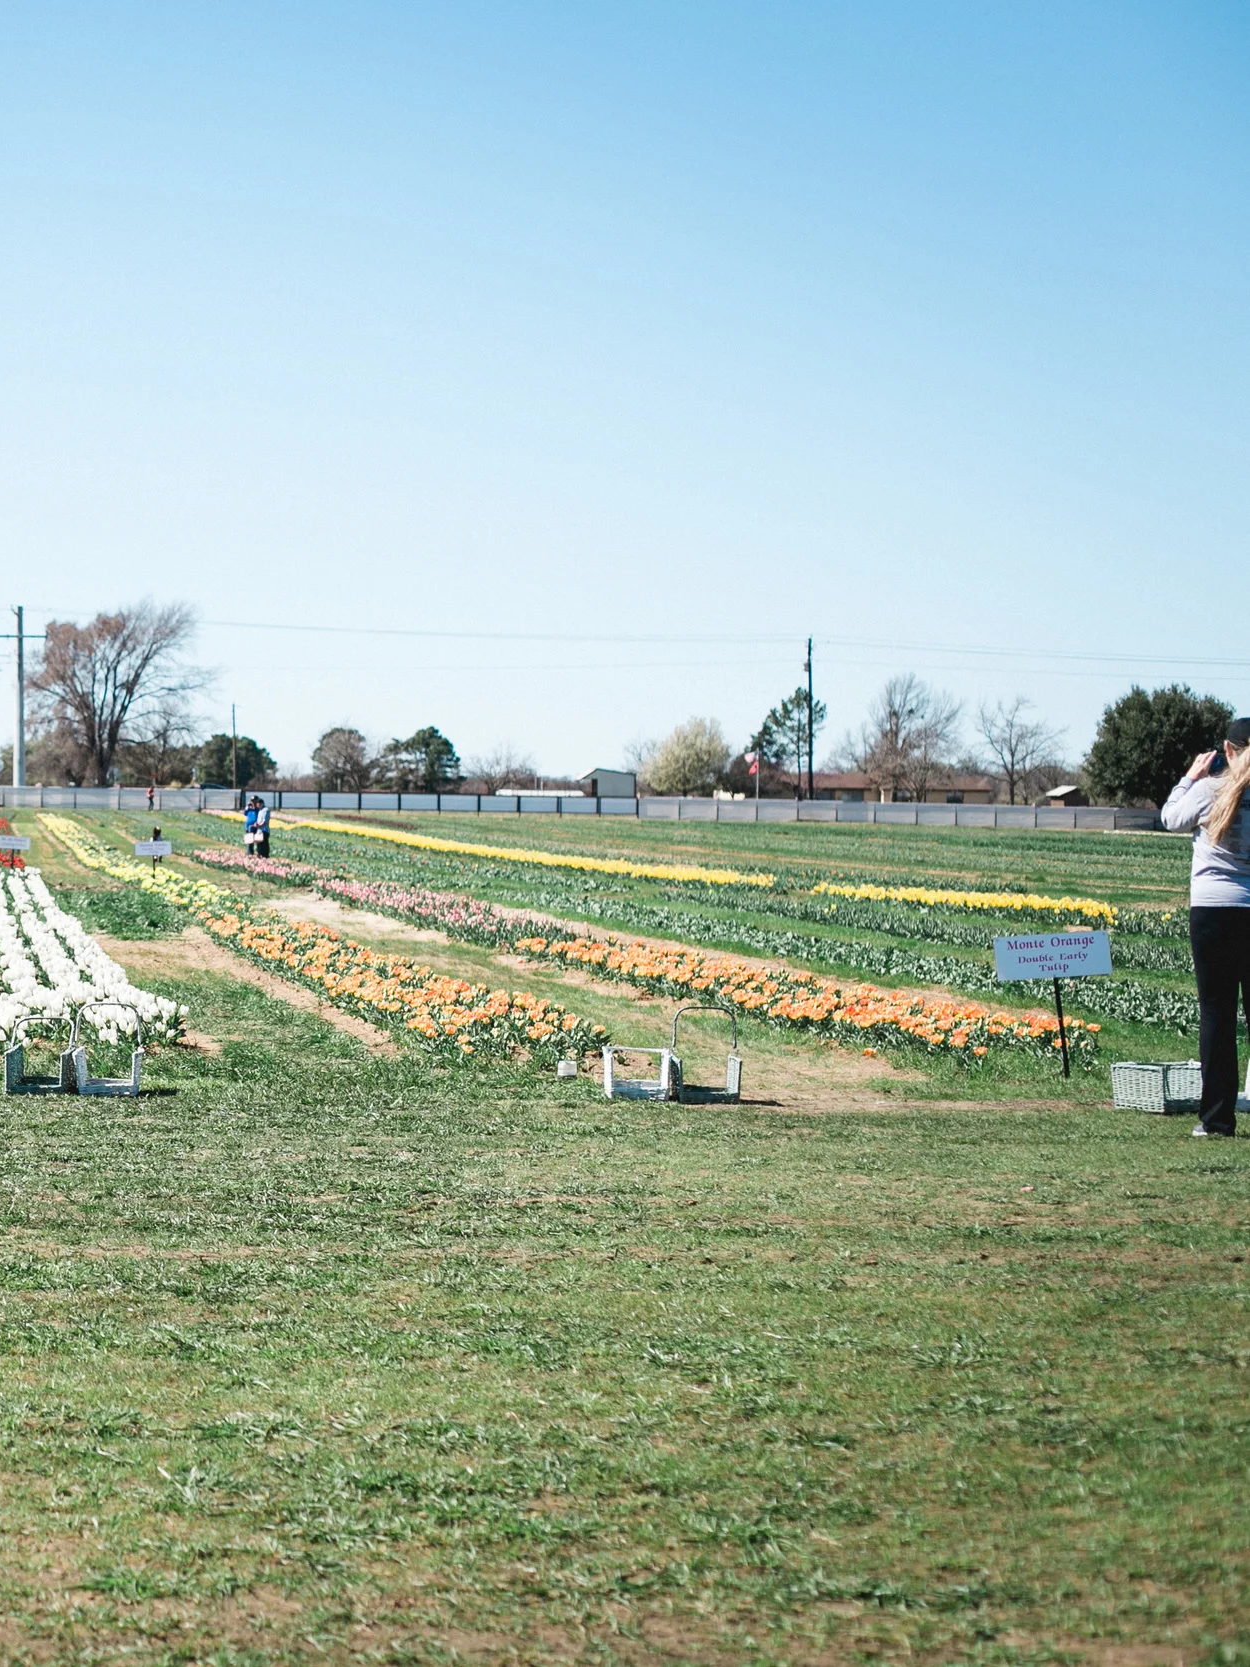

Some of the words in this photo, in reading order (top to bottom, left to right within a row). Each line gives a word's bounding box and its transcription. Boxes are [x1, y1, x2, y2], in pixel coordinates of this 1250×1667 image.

[1007, 940, 1044, 950] Monte
[1051, 936, 1095, 949] Orange
[1018, 955, 1054, 964] Double
[1060, 951, 1088, 961] Early
[1039, 963, 1069, 973] Tulip
